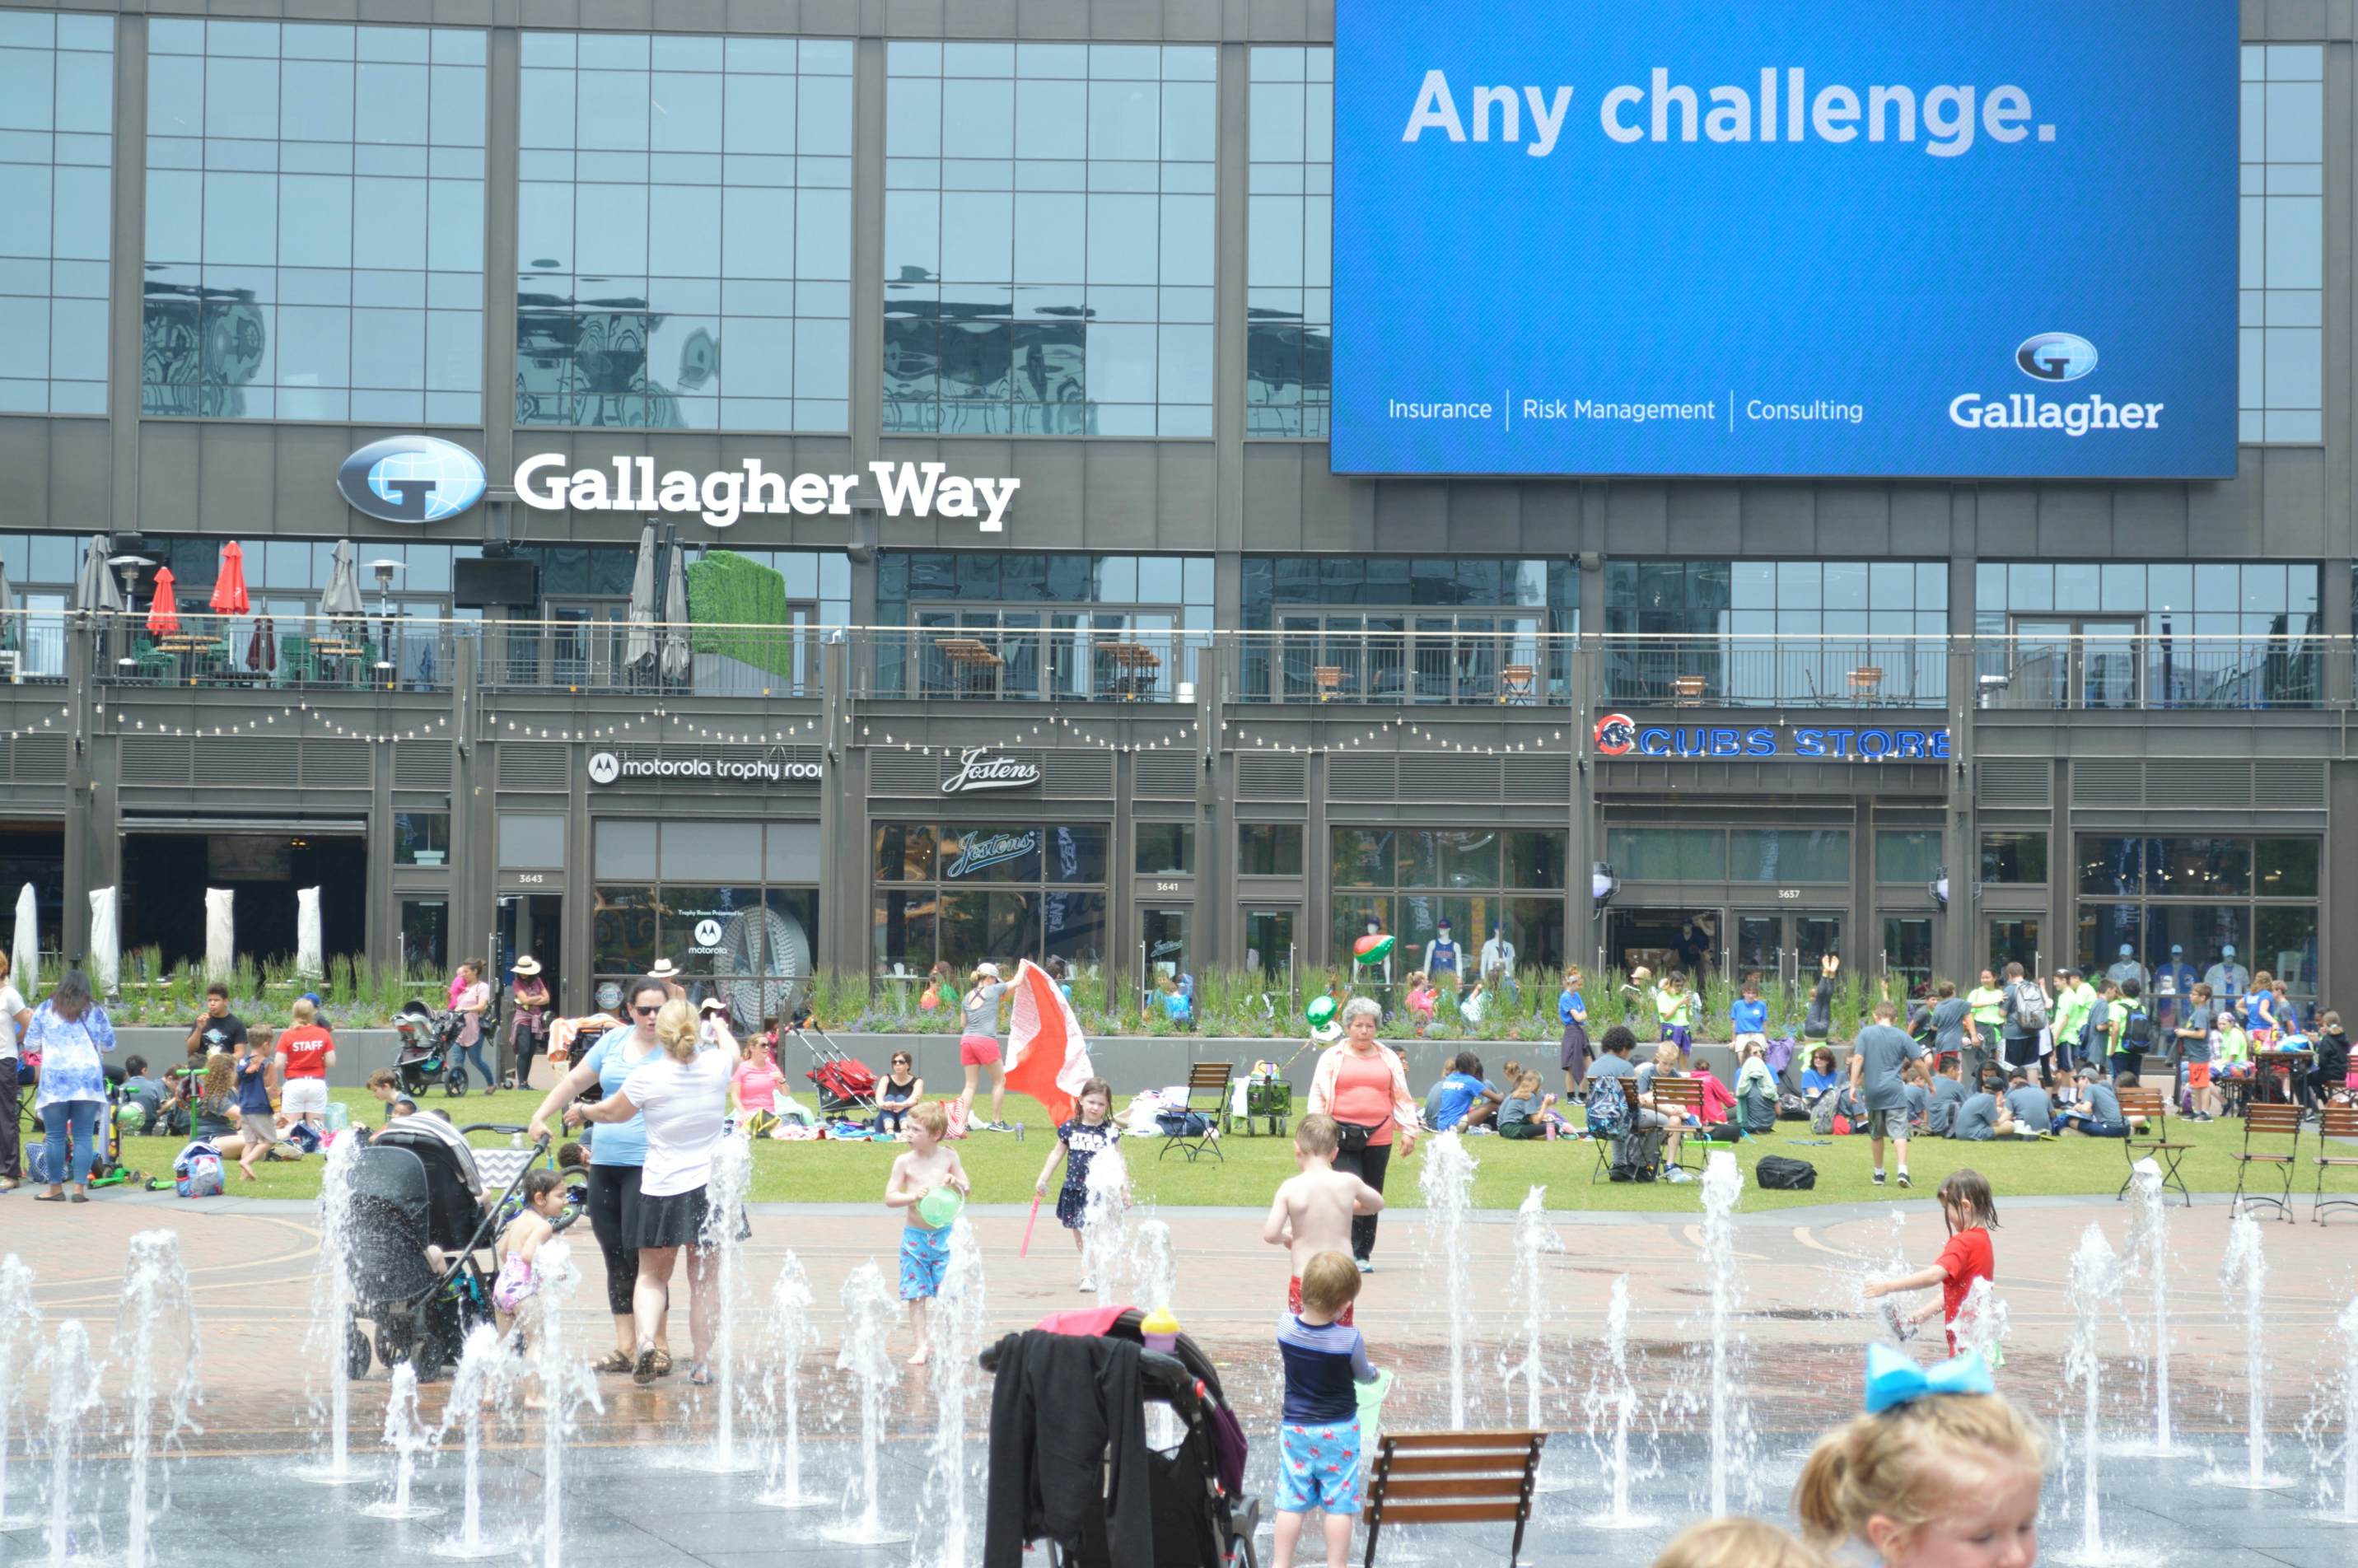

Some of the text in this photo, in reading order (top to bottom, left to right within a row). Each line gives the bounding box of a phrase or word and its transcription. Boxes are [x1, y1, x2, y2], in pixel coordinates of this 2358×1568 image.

[1402, 67, 2057, 157] Any challenge.
[1389, 399, 1492, 419] Insurance
[1523, 399, 1716, 425] Risk Management
[1746, 399, 1863, 425] Consulting
[1949, 393, 2164, 436] Gallagher
[514, 453, 1020, 532] Gallagher Way
[1639, 727, 1950, 758] CUBS STORE
[622, 758, 823, 780] motorola trophy roo
[941, 748, 1040, 792] Jostens
[947, 830, 1035, 878] Jostens
[519, 874, 544, 883] 3643
[1156, 882, 1179, 891] 3641
[1778, 889, 1801, 898] 3637
[689, 946, 728, 954] motorola
[292, 1040, 324, 1052] STAFF
[1068, 1132, 1104, 1144] STAR
